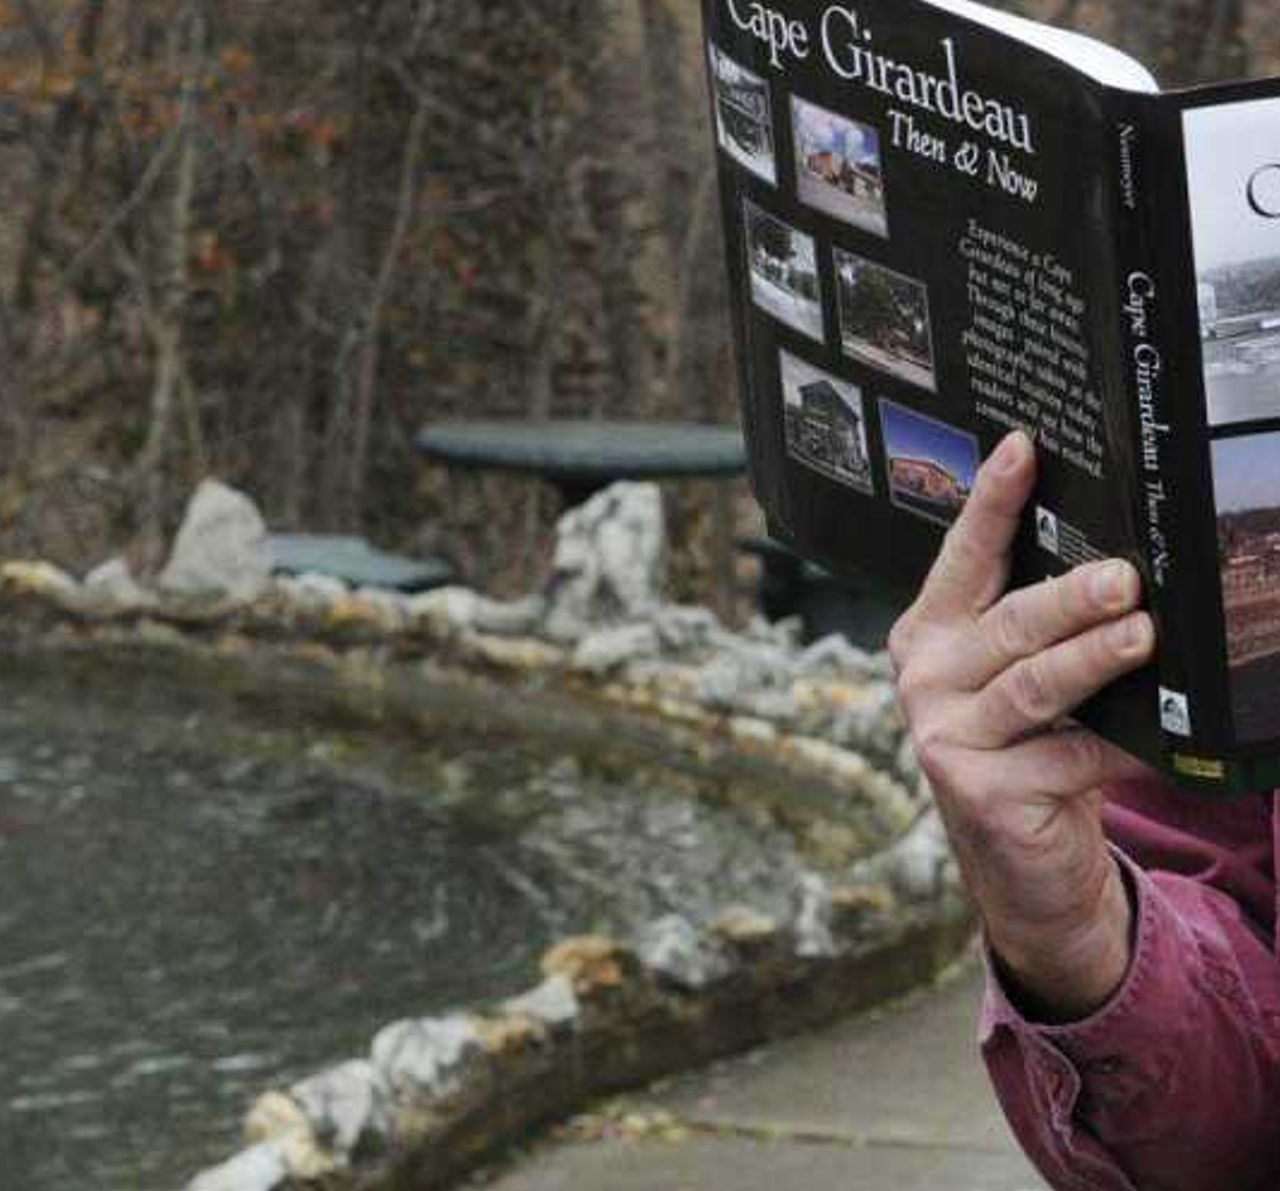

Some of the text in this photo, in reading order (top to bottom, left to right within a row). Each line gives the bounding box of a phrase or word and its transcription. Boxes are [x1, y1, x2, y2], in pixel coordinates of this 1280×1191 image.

[821, 5, 1035, 154] Girardeau
[887, 110, 1038, 203] Then & Now
[1124, 271, 1156, 337] Cape
[1134, 343, 1170, 470] Girardeau
